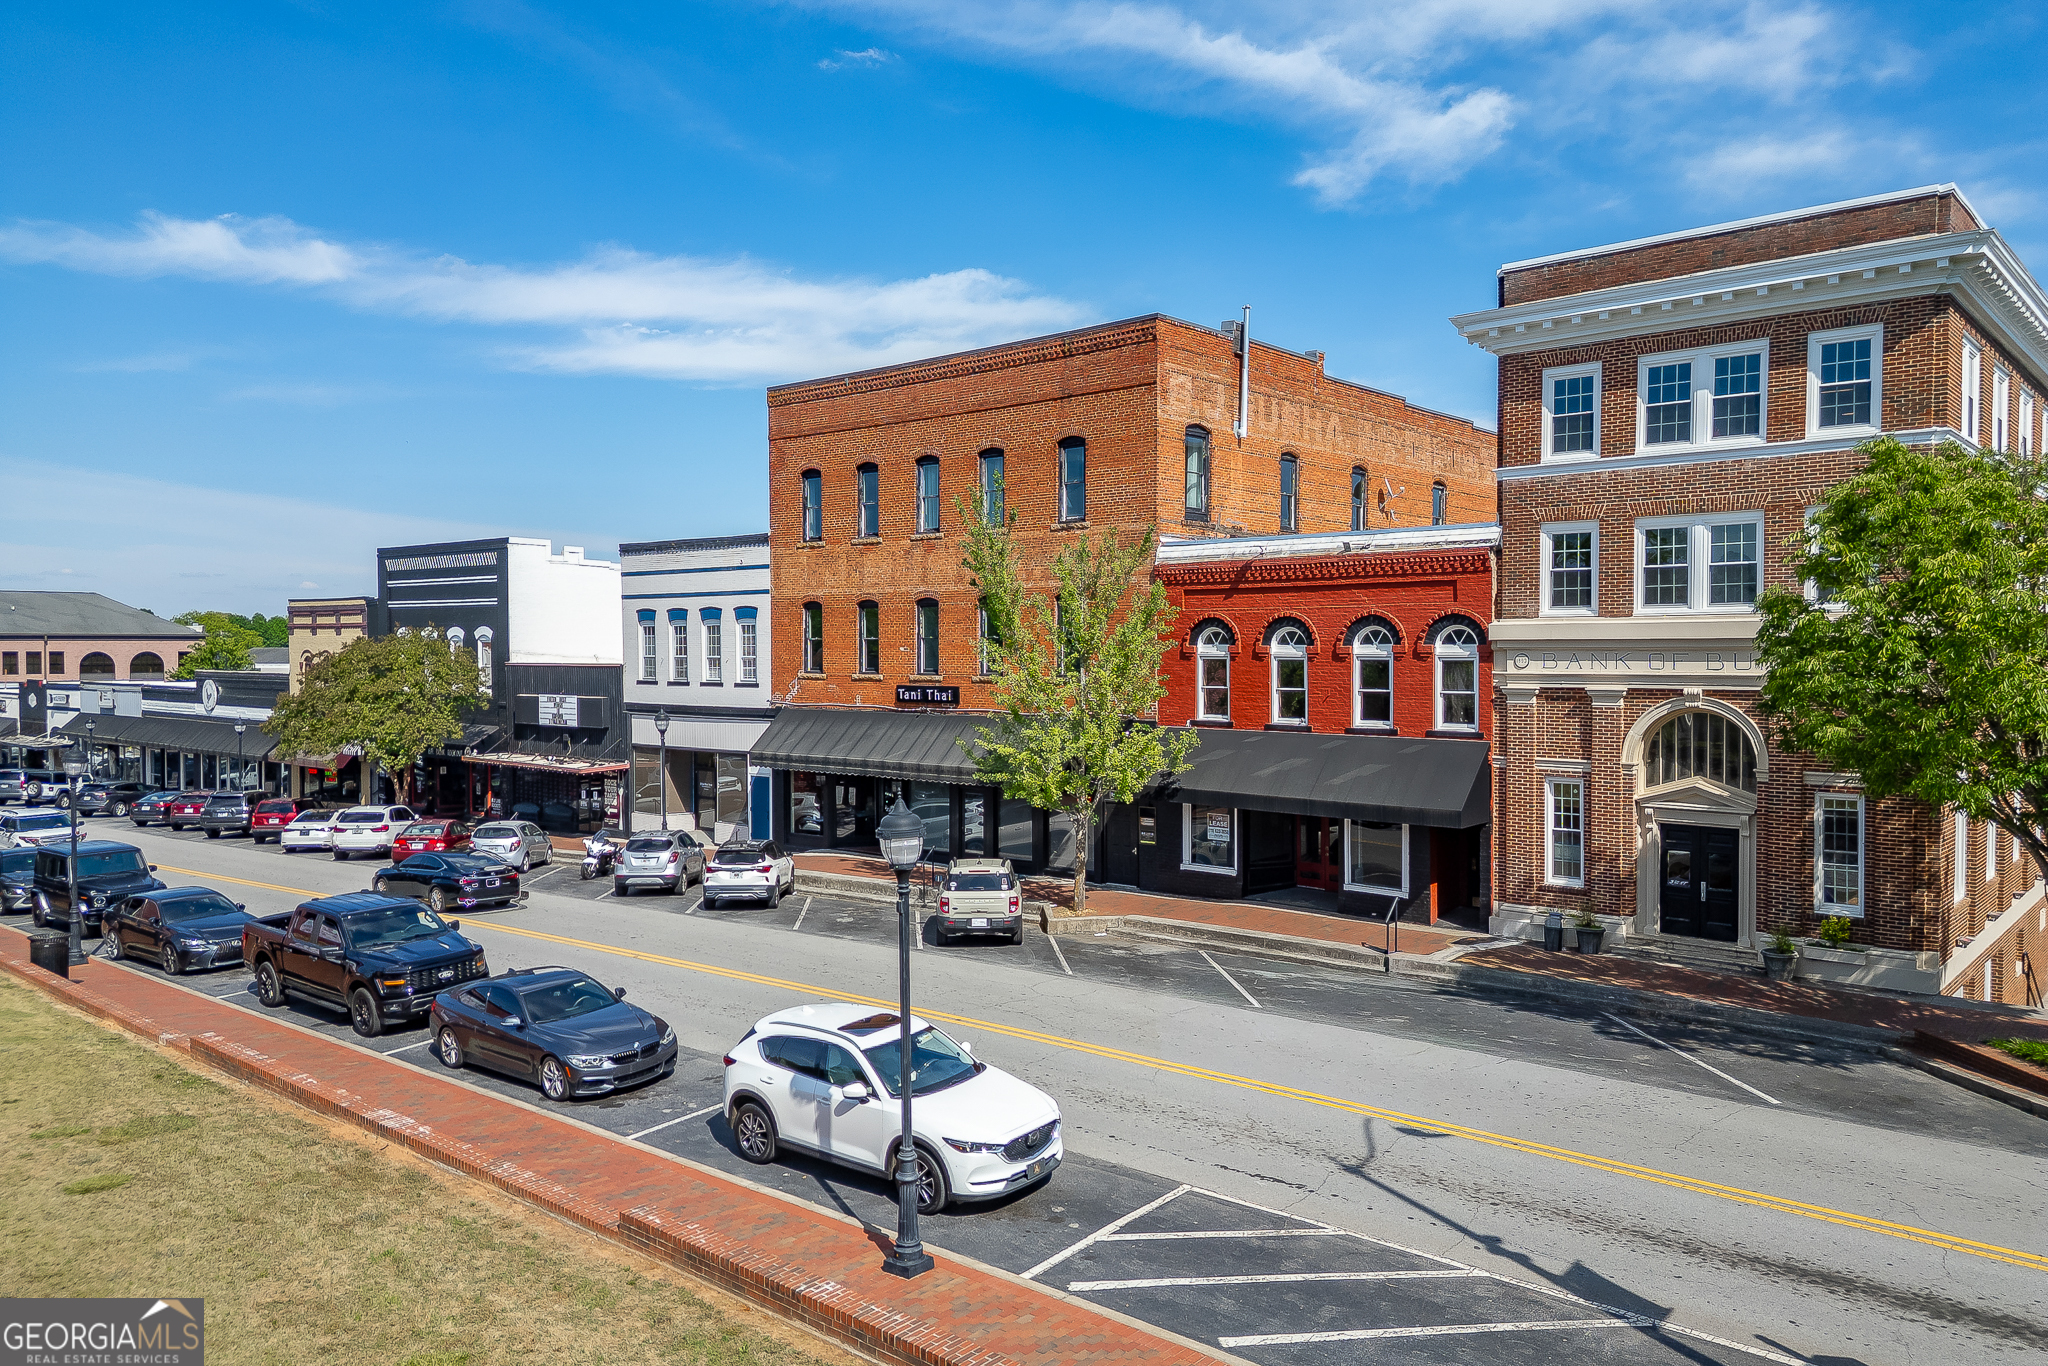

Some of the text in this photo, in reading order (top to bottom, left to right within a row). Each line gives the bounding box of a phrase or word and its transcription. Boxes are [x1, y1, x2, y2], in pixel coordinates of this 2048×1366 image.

[1541, 652, 1755, 671] BANK OF BU
[898, 688, 953, 701] Tani Thai
[604, 778, 617, 786] ROCK
